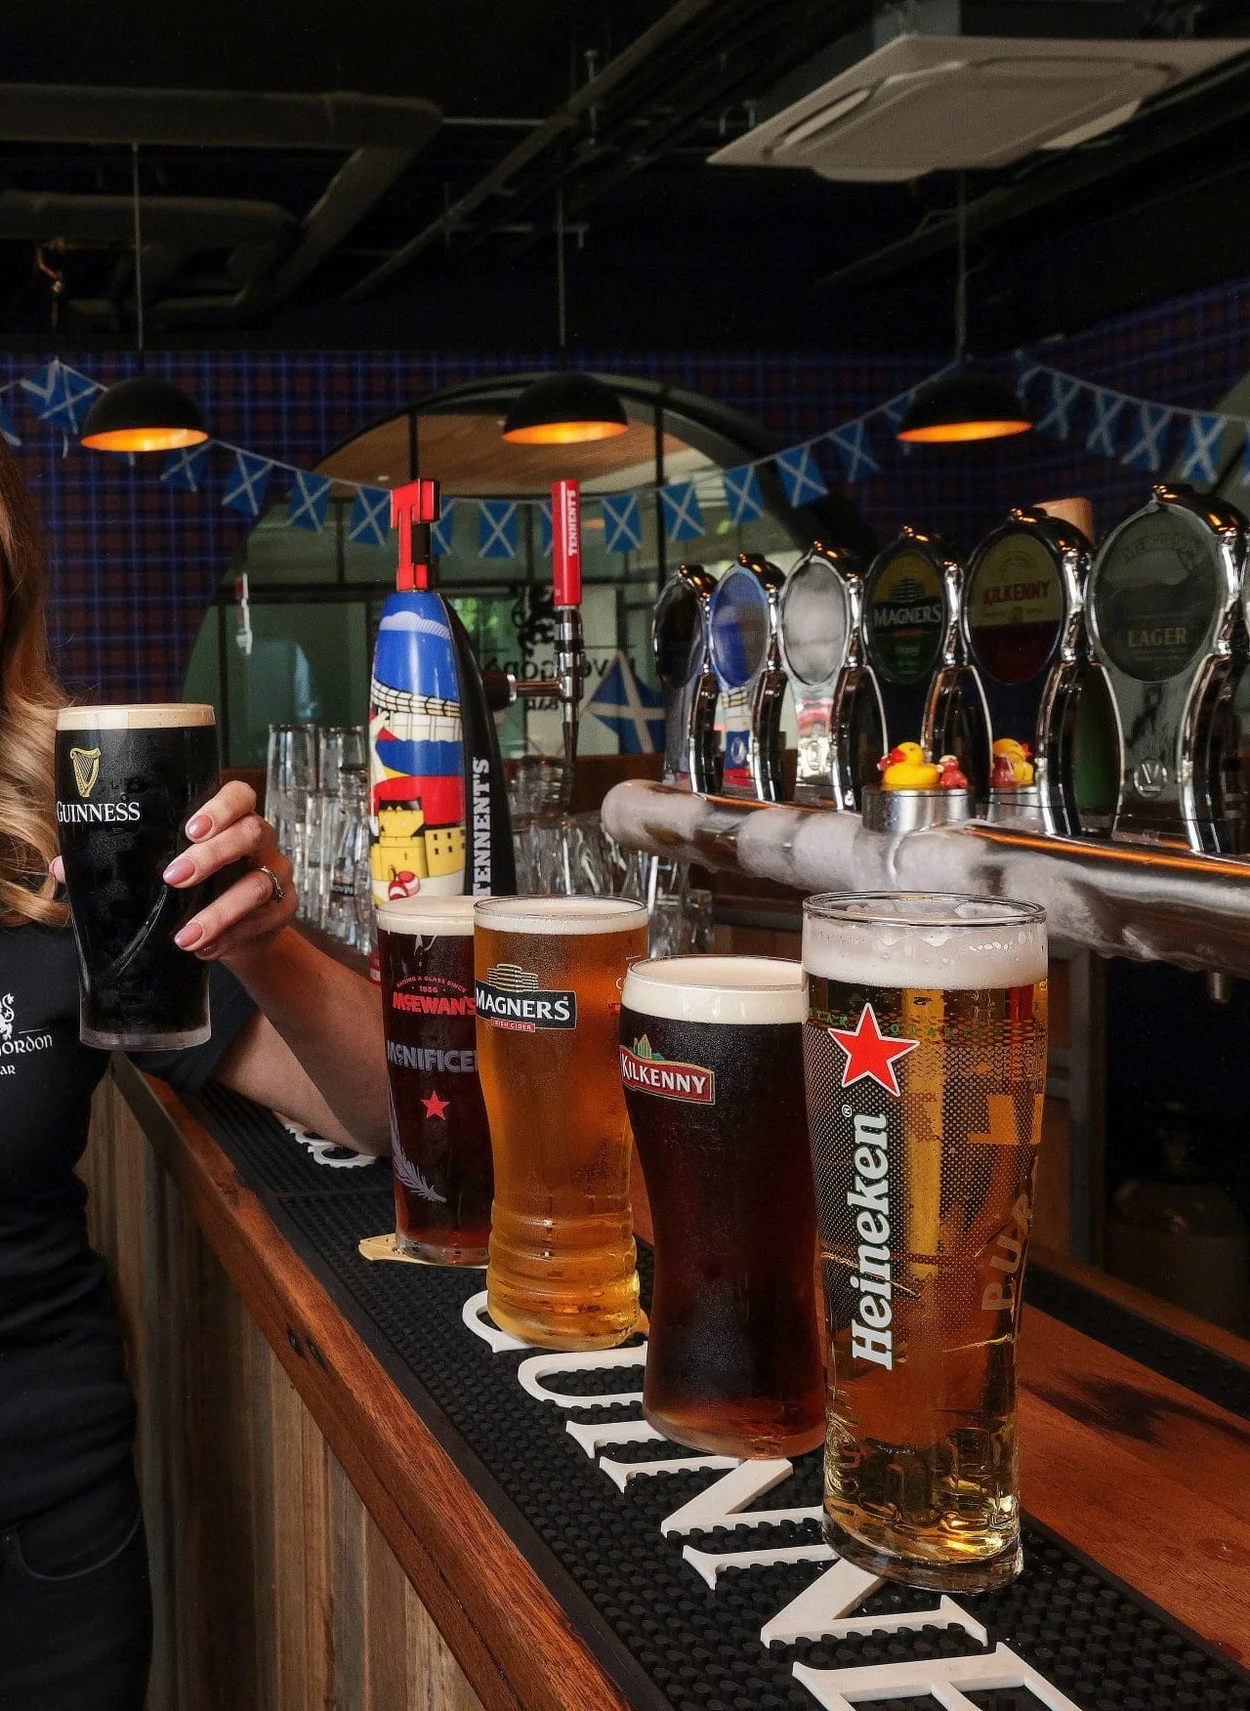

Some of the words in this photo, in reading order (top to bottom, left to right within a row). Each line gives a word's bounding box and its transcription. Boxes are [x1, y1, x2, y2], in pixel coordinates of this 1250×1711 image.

[873, 603, 943, 628] MAGNERS
[1128, 626, 1188, 649] LAGER
[56, 800, 141, 823] GUINNESS
[476, 986, 570, 1021] MAGNERS
[510, 1022, 532, 1031] CIDER
[621, 1052, 707, 1094] KILKENNY
[848, 1111, 894, 1371] Heineken
